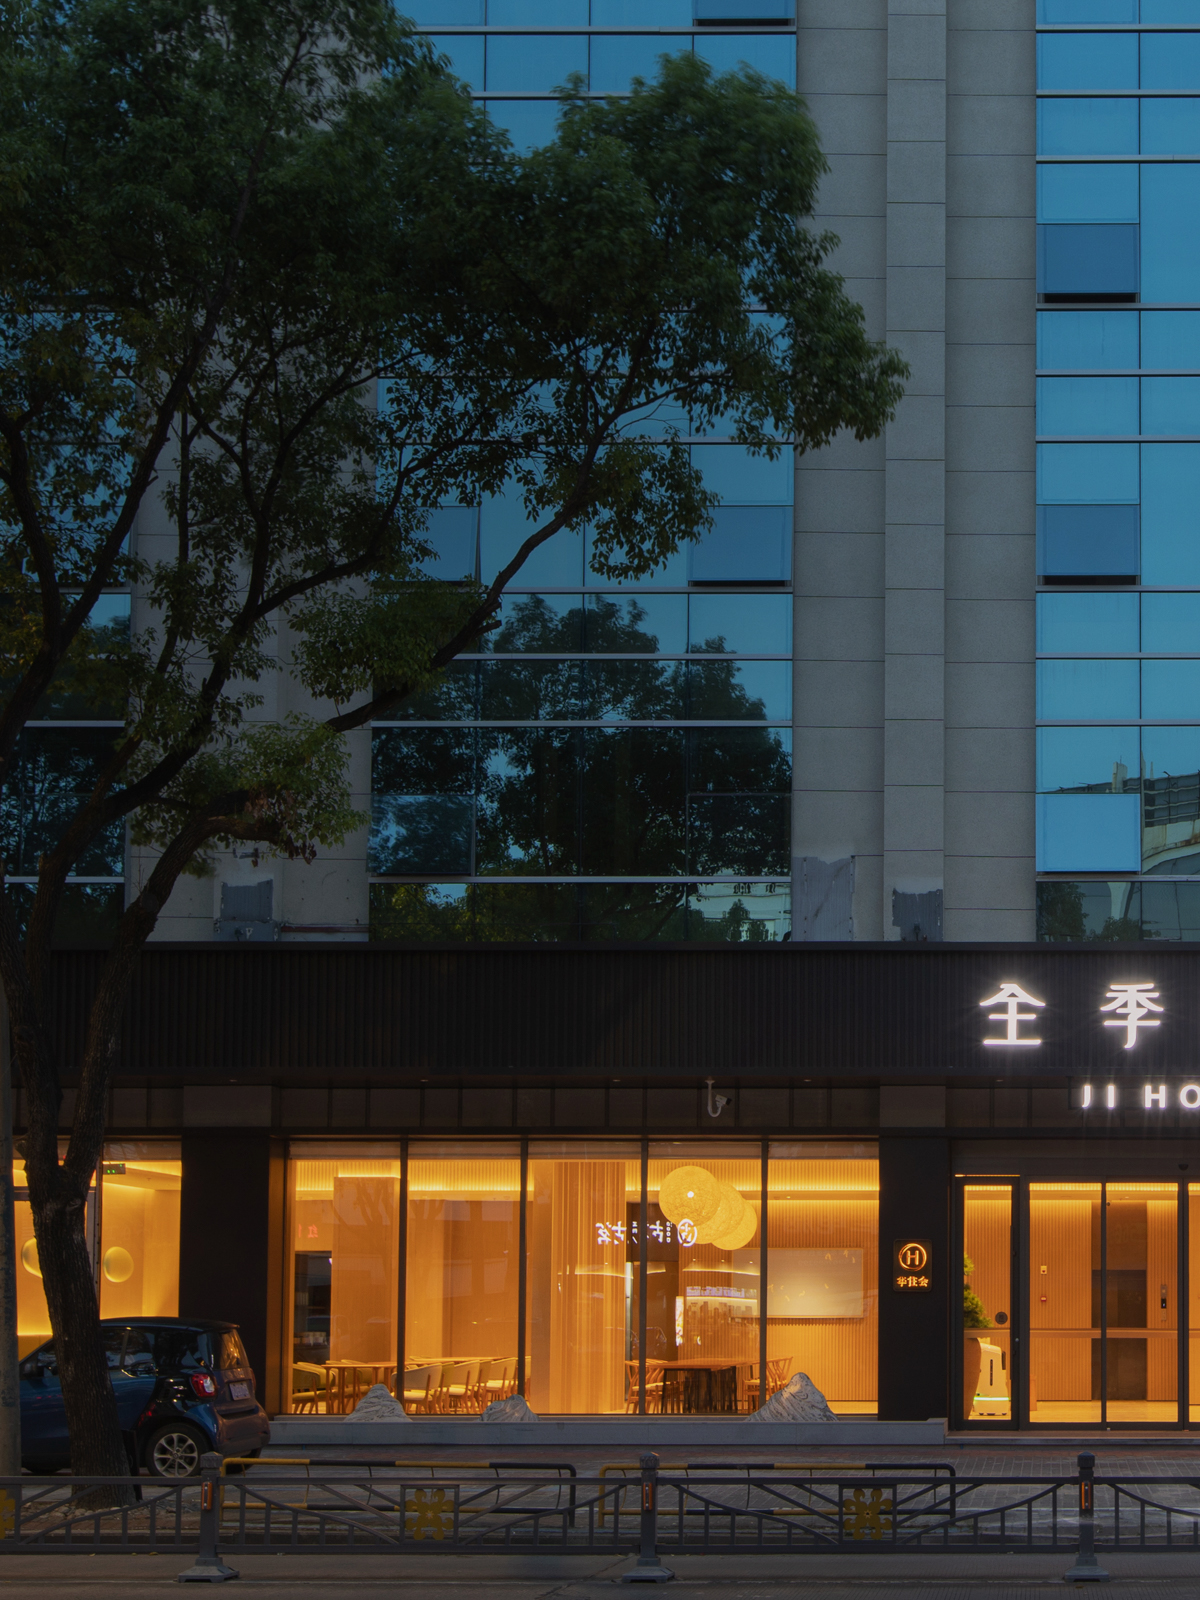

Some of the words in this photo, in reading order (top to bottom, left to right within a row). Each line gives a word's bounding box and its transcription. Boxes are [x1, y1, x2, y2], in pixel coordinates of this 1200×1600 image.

[1082, 1084, 1115, 1108] JI
[896, 1276, 929, 1288] 华住会
